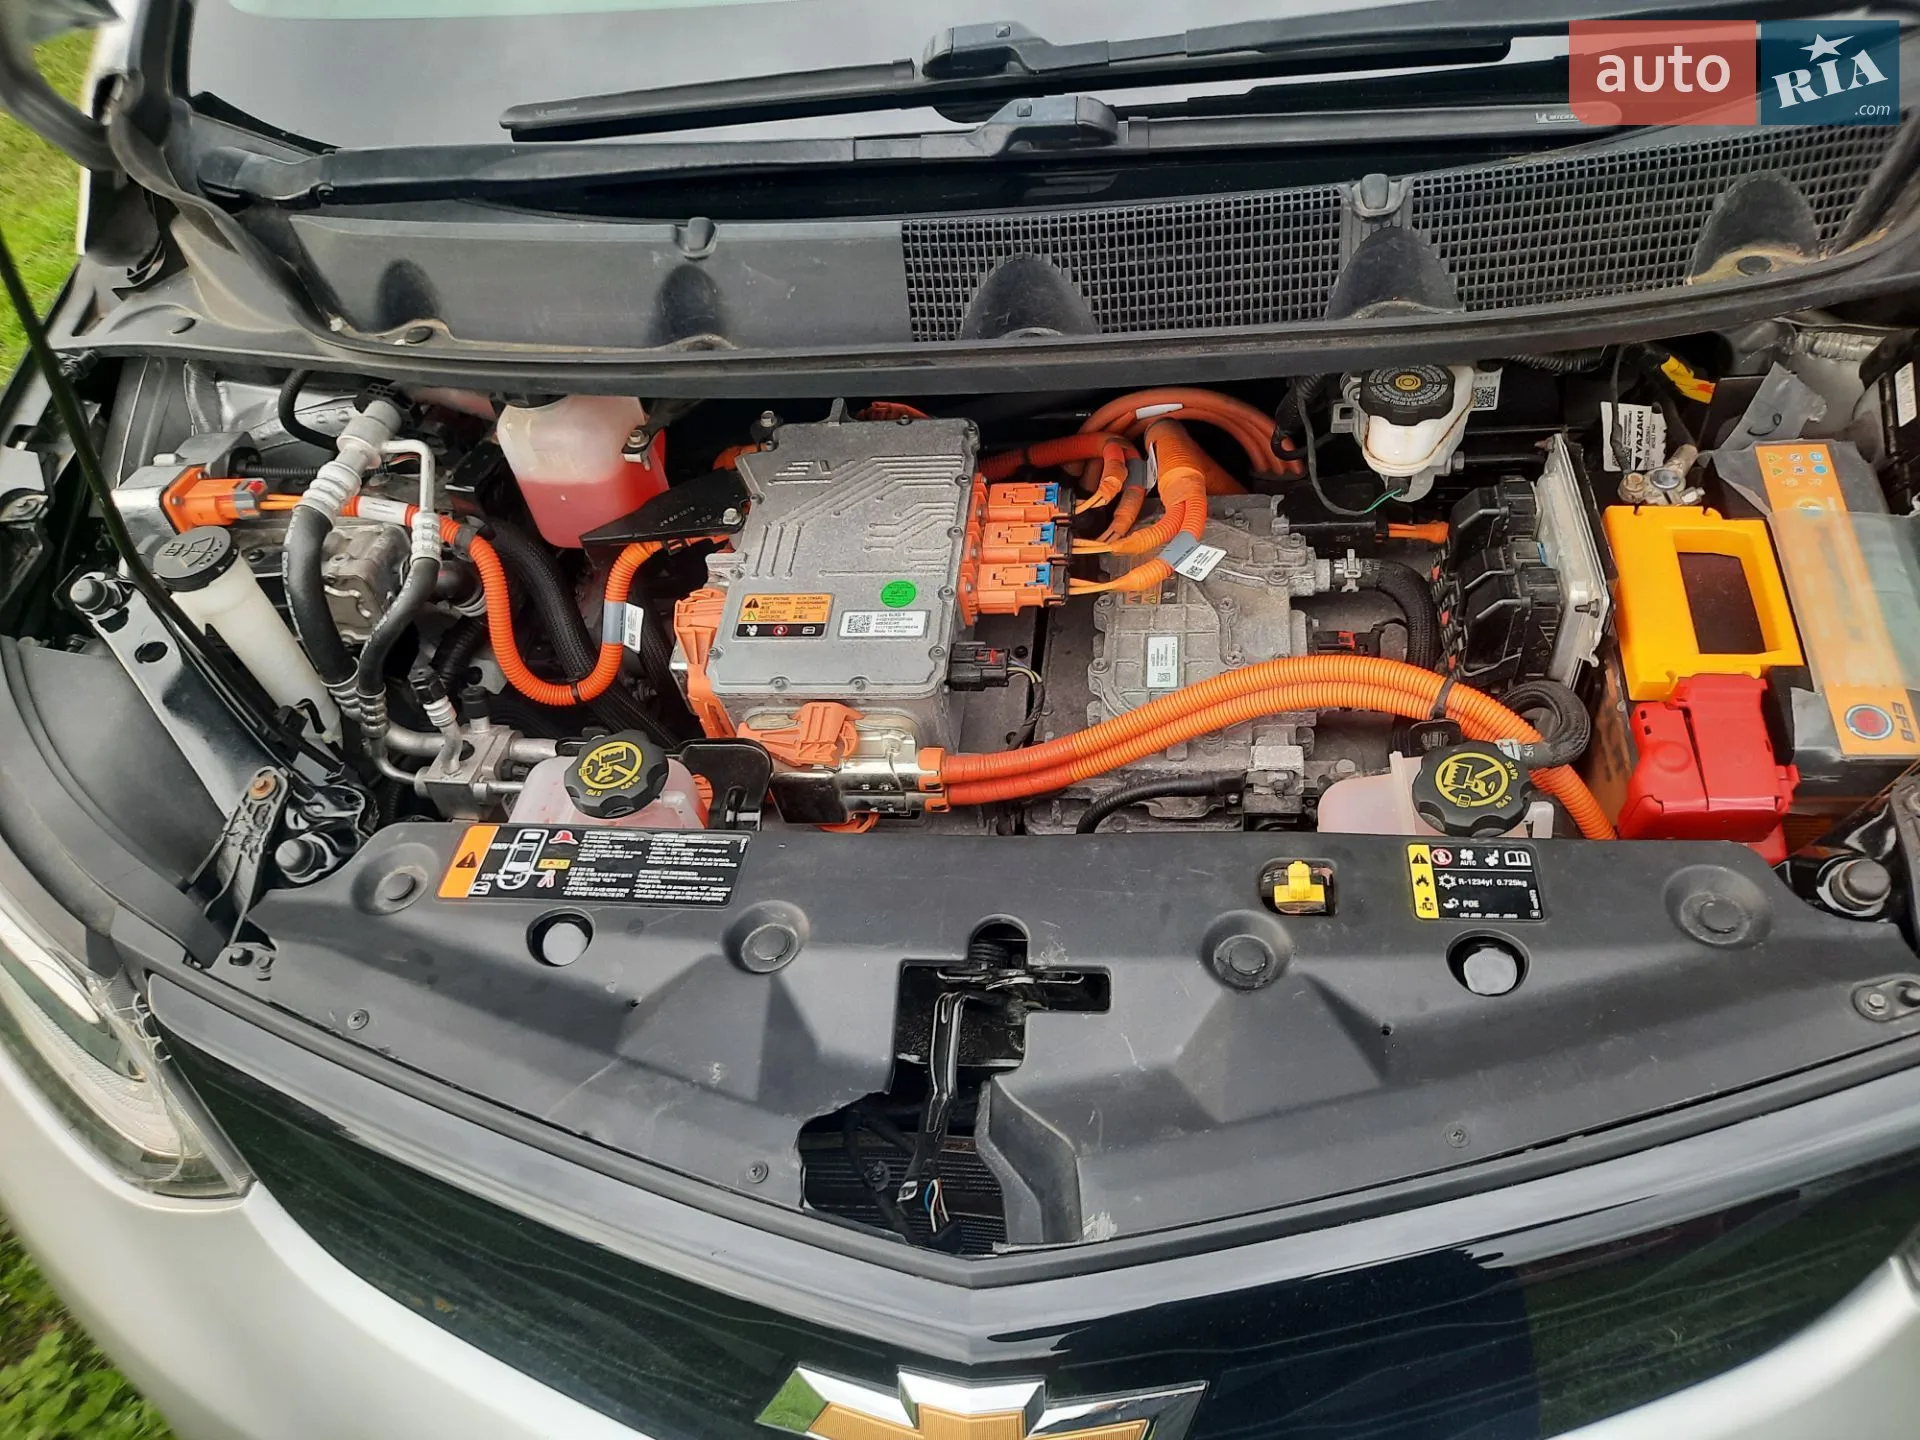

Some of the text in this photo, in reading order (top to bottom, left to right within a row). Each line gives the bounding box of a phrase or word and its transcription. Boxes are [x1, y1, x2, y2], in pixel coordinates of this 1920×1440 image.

[1635, 410, 1643, 454] YAZAKI
[1458, 878, 1493, 887] R-1234yf
[1462, 899, 1480, 908] POE
